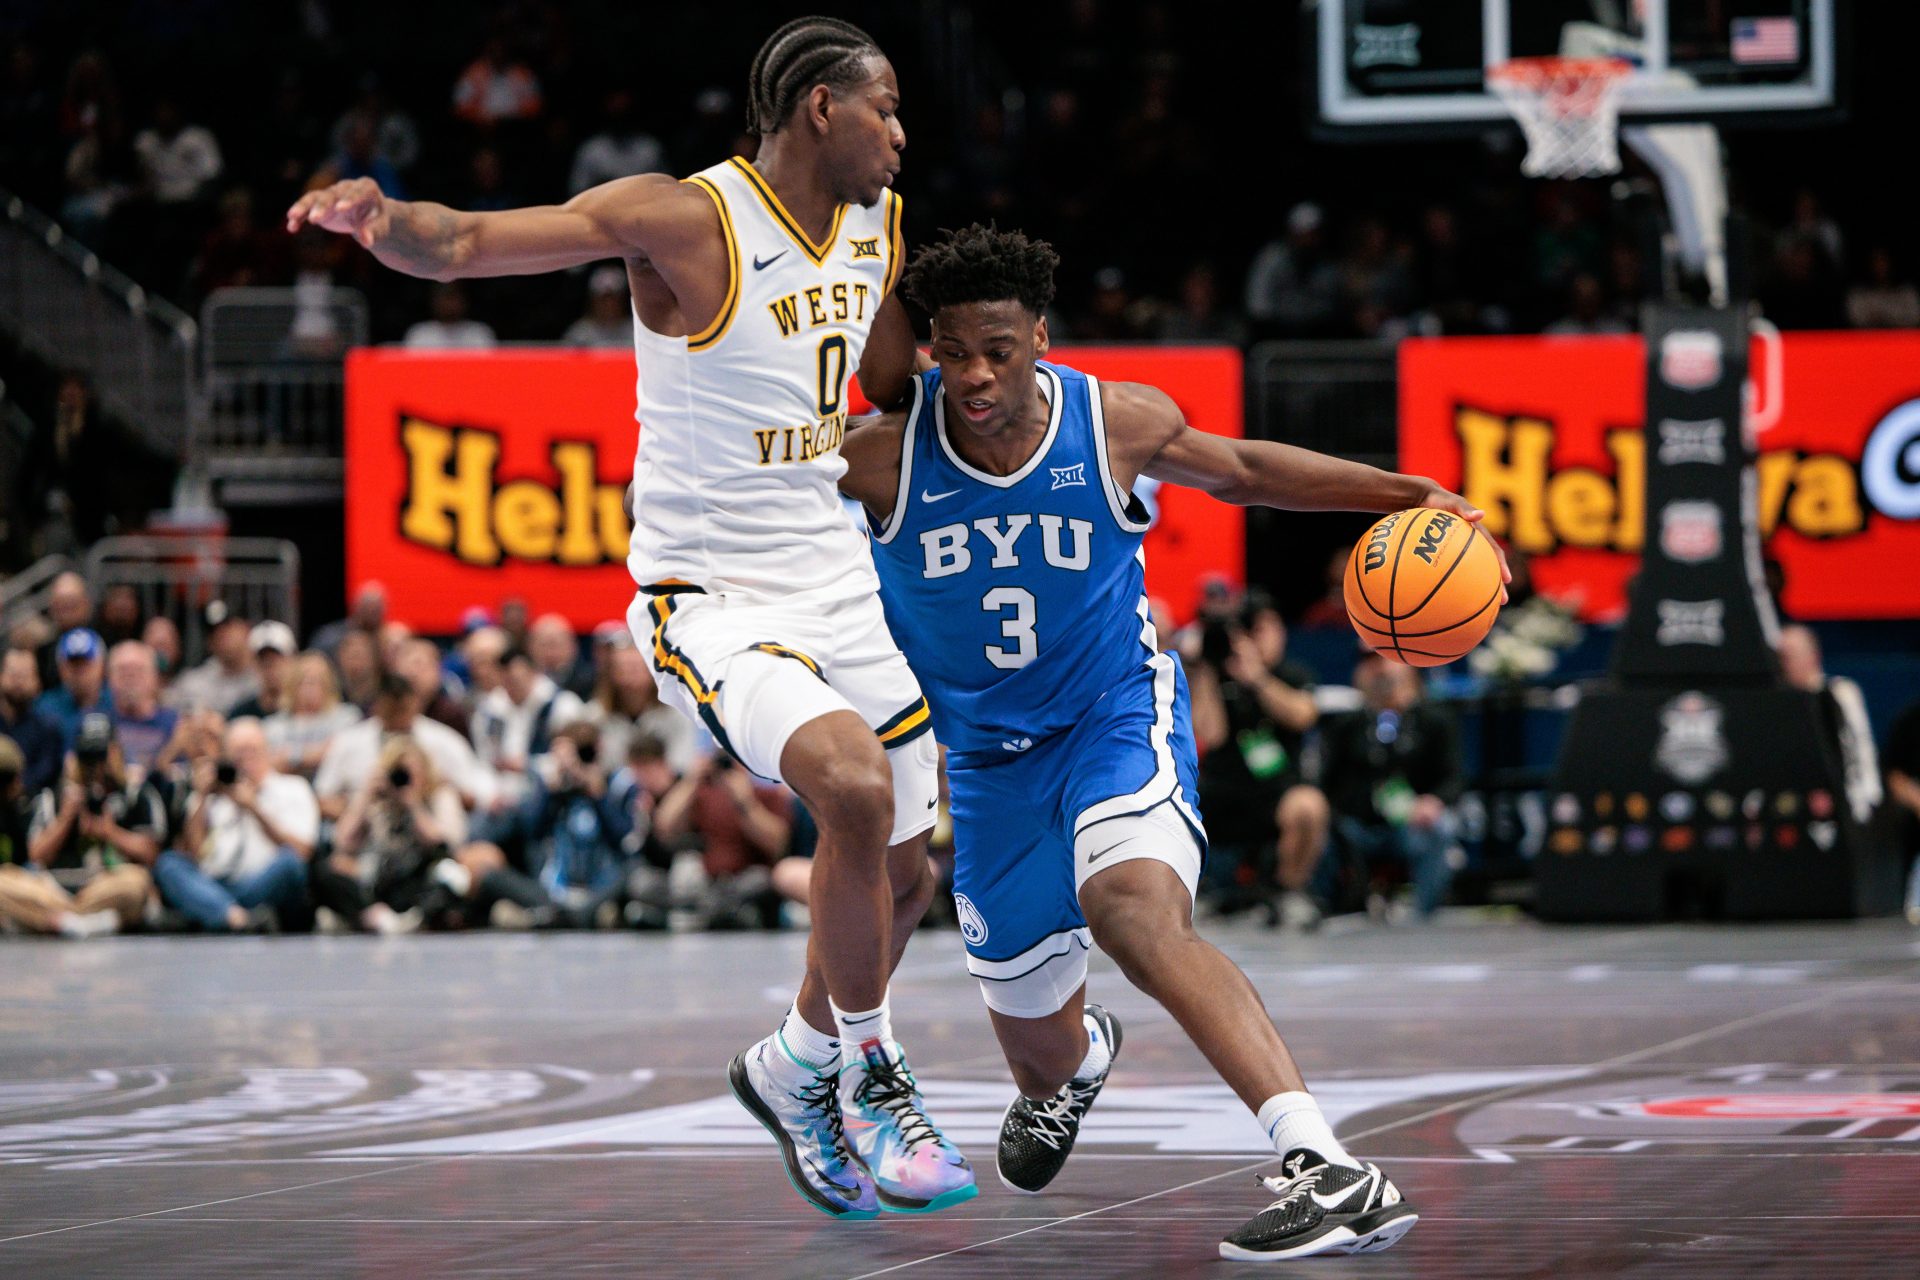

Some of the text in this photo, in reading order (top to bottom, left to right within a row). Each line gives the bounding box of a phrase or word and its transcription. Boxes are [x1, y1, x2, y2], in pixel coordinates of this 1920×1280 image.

[768, 282, 868, 339] WEST
[816, 332, 849, 419] 0
[1455, 405, 1866, 555] Helva
[919, 513, 1094, 579] BYU
[1412, 511, 1458, 565] NCAA
[981, 586, 1039, 670] 3
